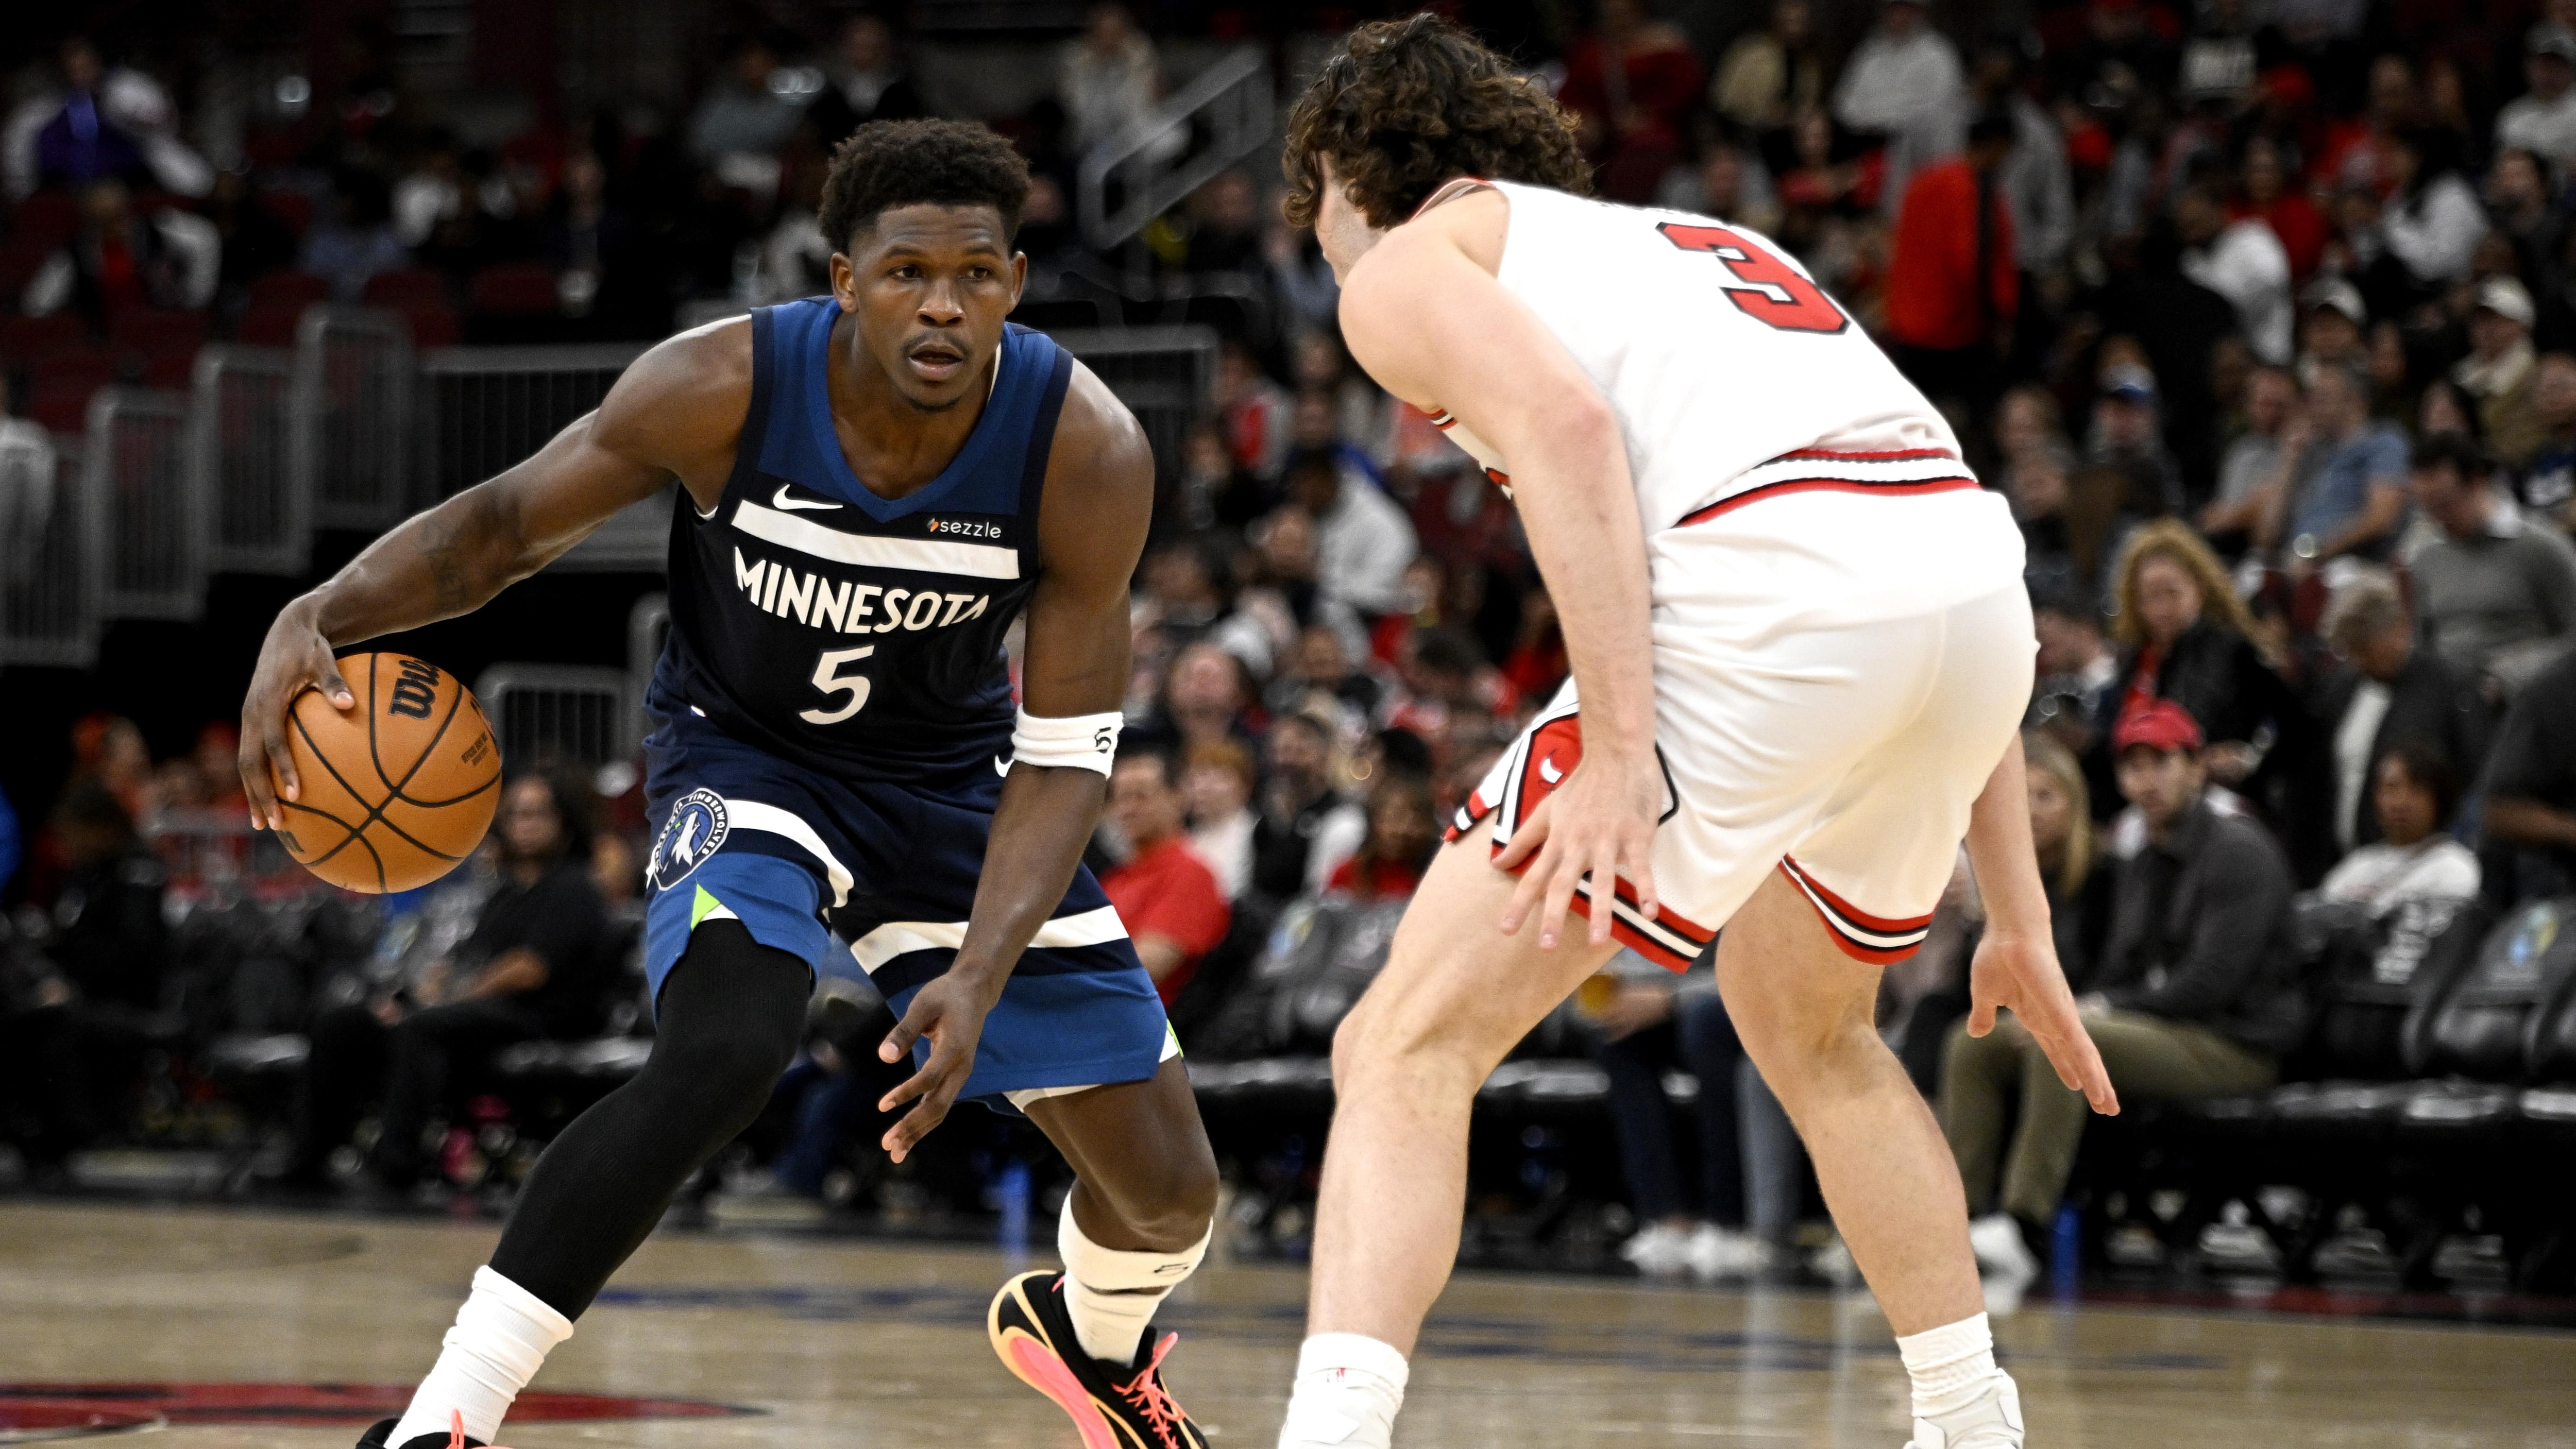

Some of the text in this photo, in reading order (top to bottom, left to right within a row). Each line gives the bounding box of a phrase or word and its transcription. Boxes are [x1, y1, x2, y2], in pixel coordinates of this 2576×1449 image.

[1655, 220, 1852, 336] 3
[940, 521, 1002, 539] sezzle
[735, 546, 989, 634] MINNESOTA
[799, 644, 875, 725] 5
[1094, 726, 1112, 754] 5
[688, 793, 725, 855] TIMBERWOLVES
